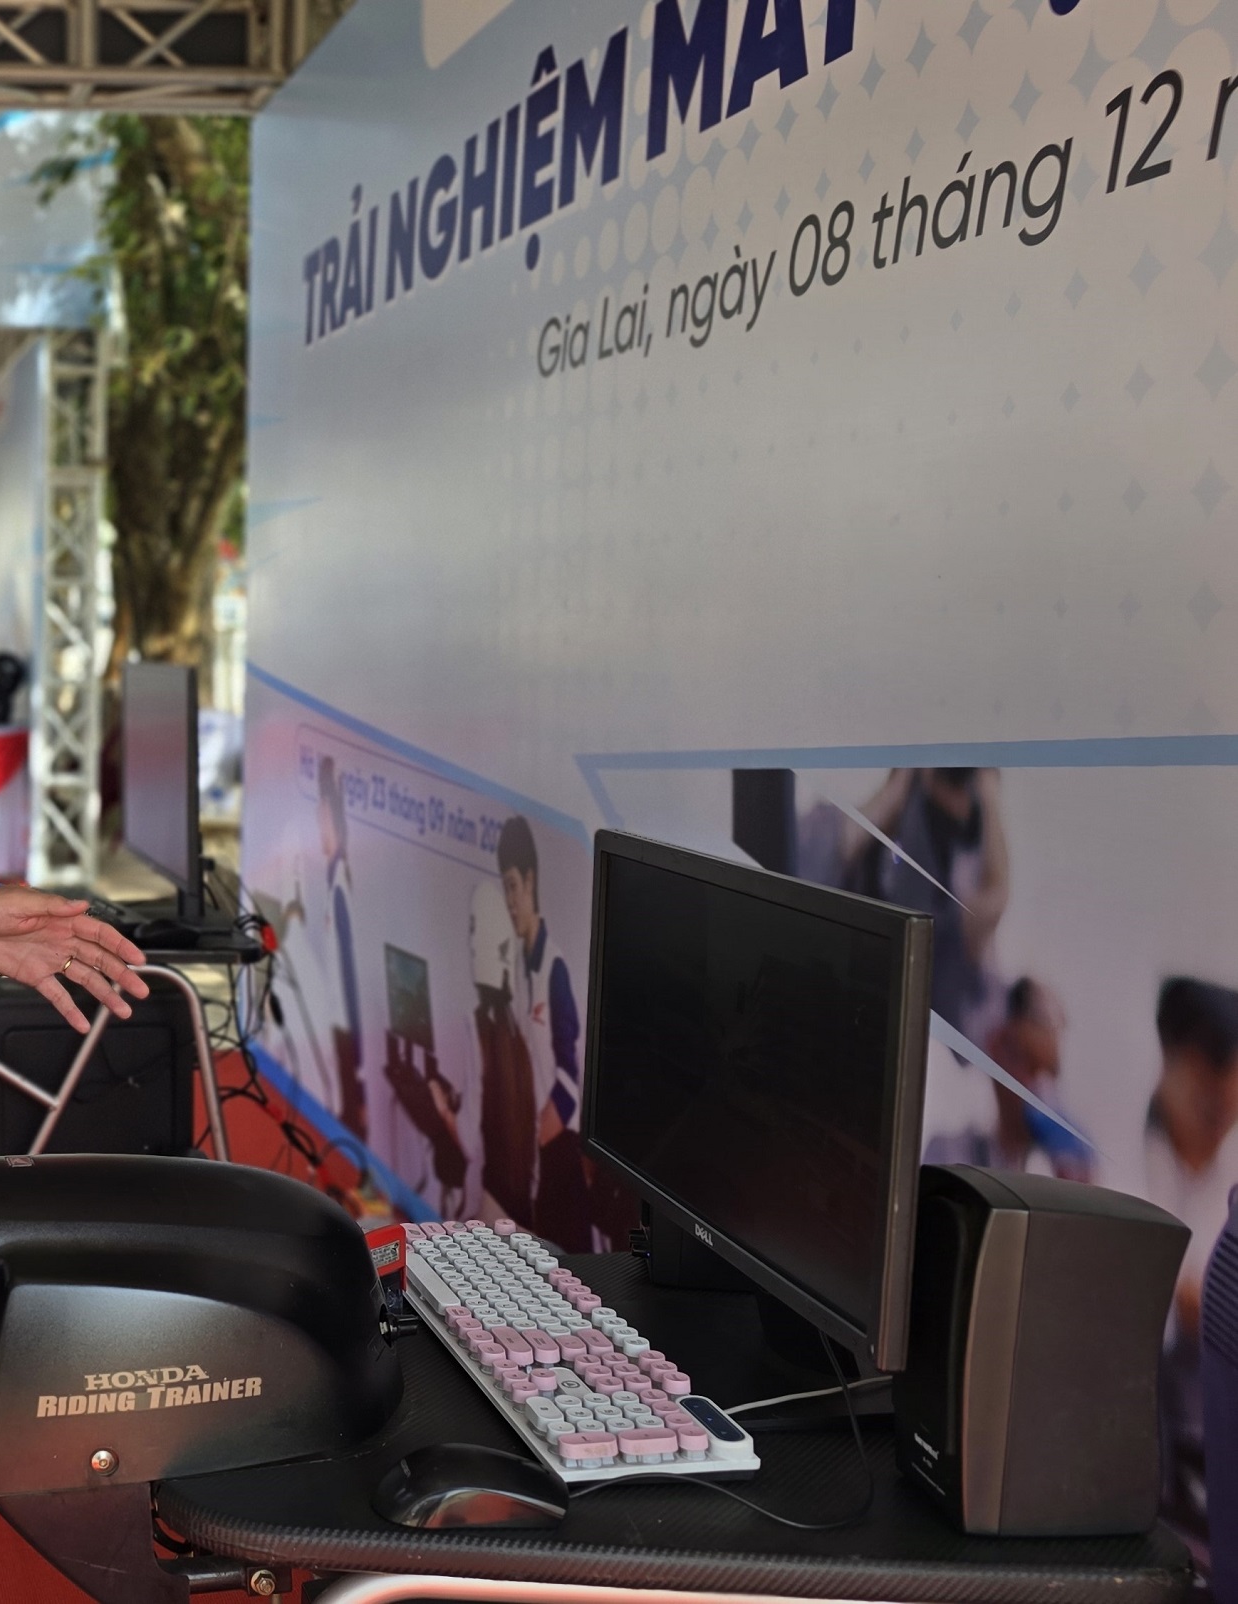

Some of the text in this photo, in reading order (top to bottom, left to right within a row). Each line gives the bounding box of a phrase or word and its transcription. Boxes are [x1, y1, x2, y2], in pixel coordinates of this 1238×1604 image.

[304, 183, 378, 346] TRẢI
[385, 26, 628, 302] NGHIỆM
[537, 314, 590, 378] Gia
[598, 283, 653, 358] Lai,
[665, 244, 777, 348] ngày
[788, 200, 855, 297] 08
[871, 136, 1074, 269] tháng
[1105, 69, 1184, 194] 12
[694, 1223, 714, 1247] DELL
[36, 1376, 262, 1418] RIDING TRAINER
[84, 1364, 210, 1392] HONDA
